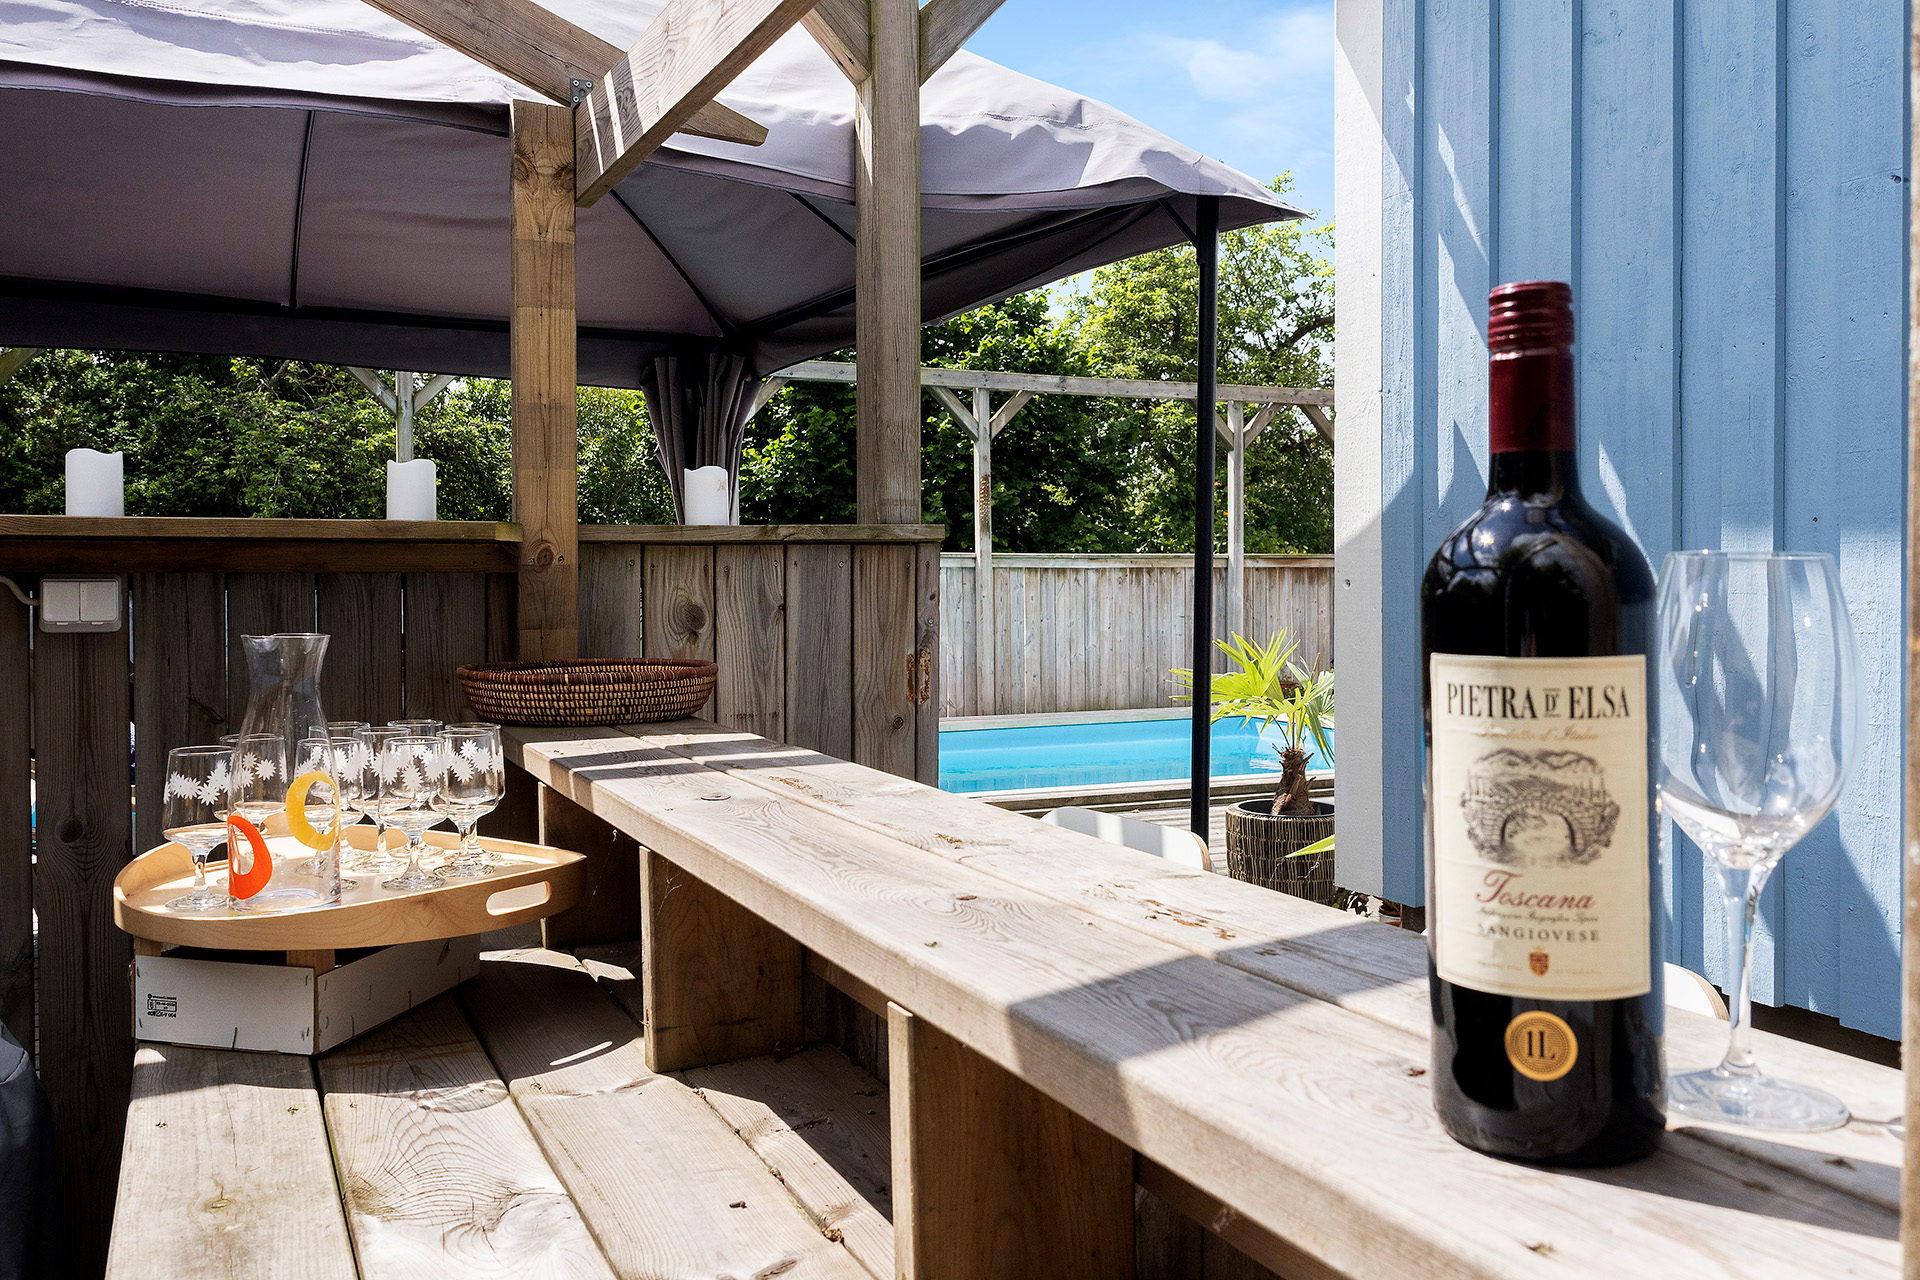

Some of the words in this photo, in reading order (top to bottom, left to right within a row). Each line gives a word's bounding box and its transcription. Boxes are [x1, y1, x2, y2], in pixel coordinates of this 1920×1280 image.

[1447, 683, 1538, 719] PIETRA
[1569, 685, 1630, 719] ELSA
[1476, 869, 1596, 910] Toscana
[1477, 922, 1601, 943] SANGIOVESE
